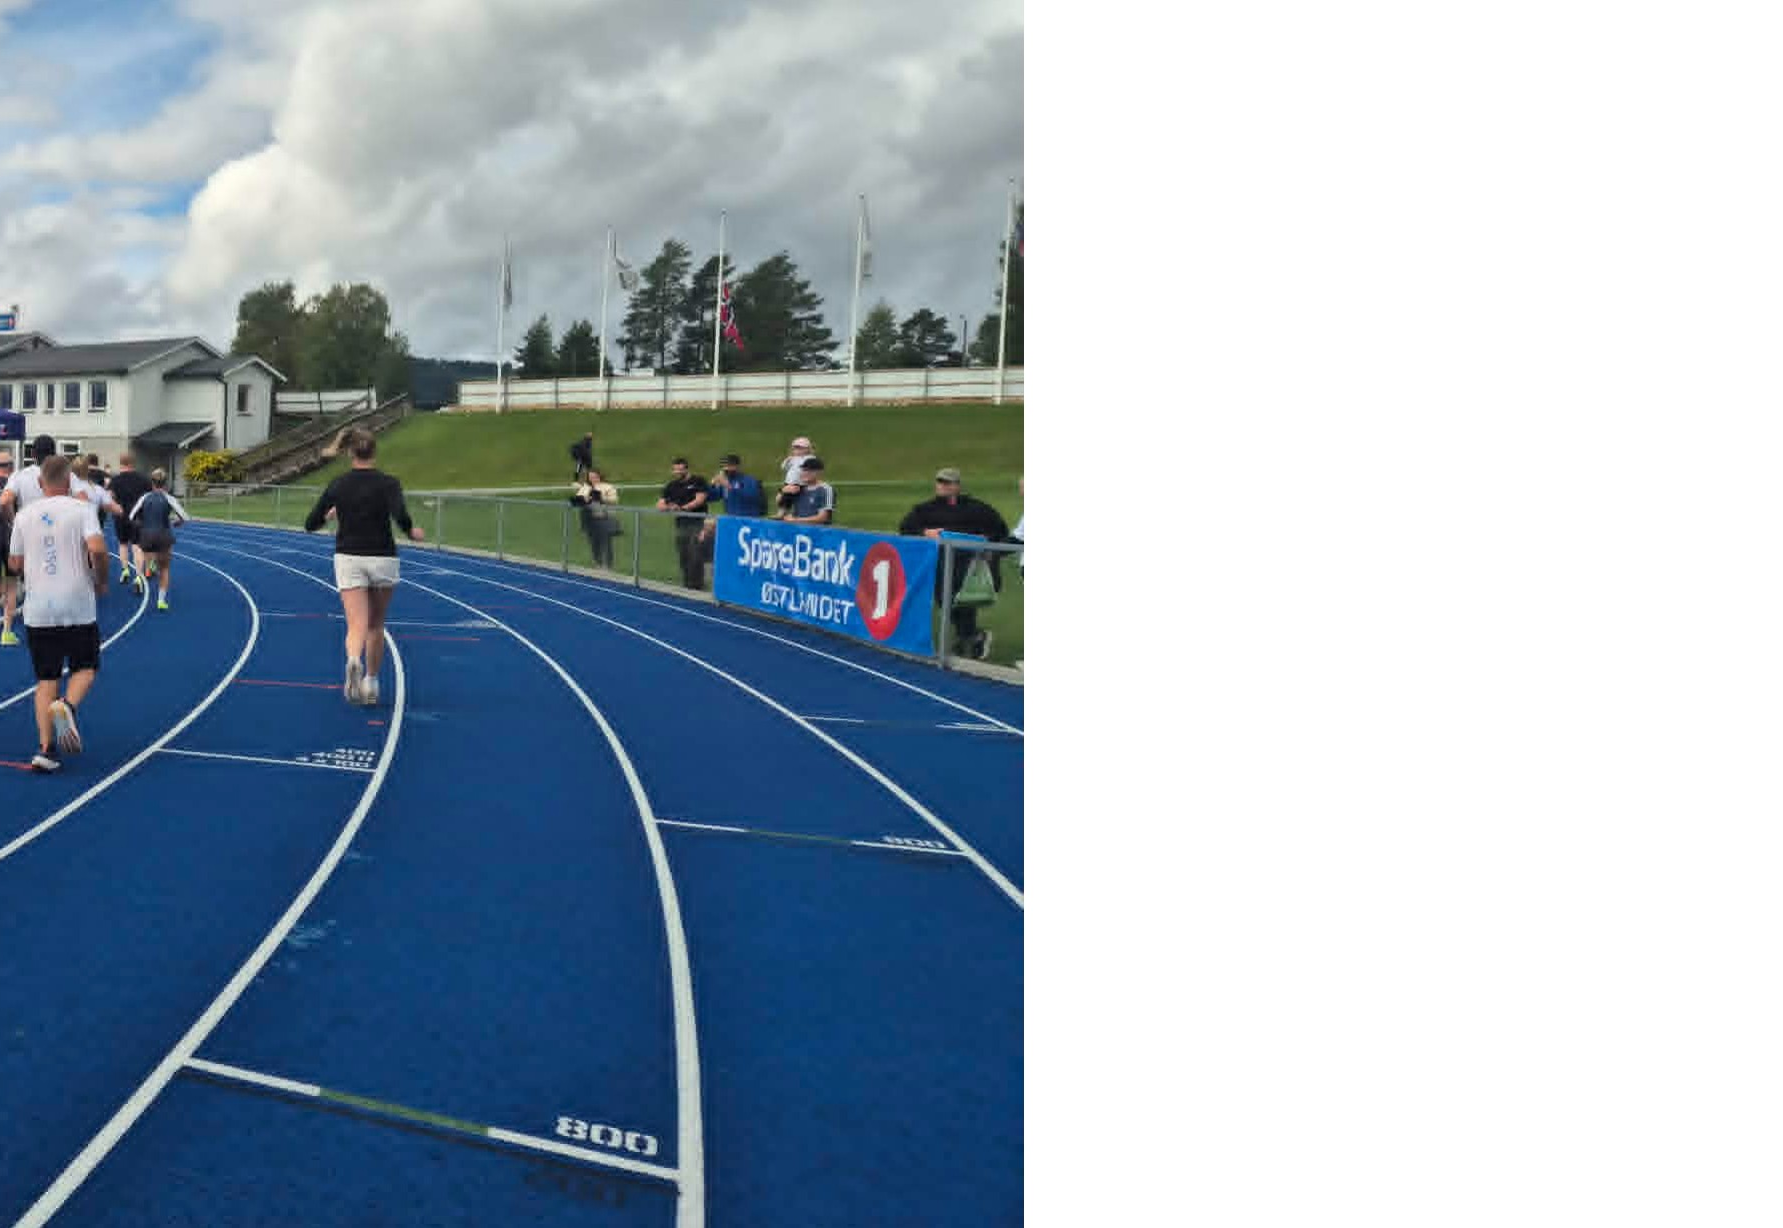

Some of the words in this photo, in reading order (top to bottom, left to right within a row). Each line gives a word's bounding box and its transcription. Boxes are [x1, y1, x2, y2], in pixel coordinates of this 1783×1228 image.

[737, 526, 855, 586] SpareBank
[872, 560, 891, 619] 1
[556, 1116, 658, 1156] 800
